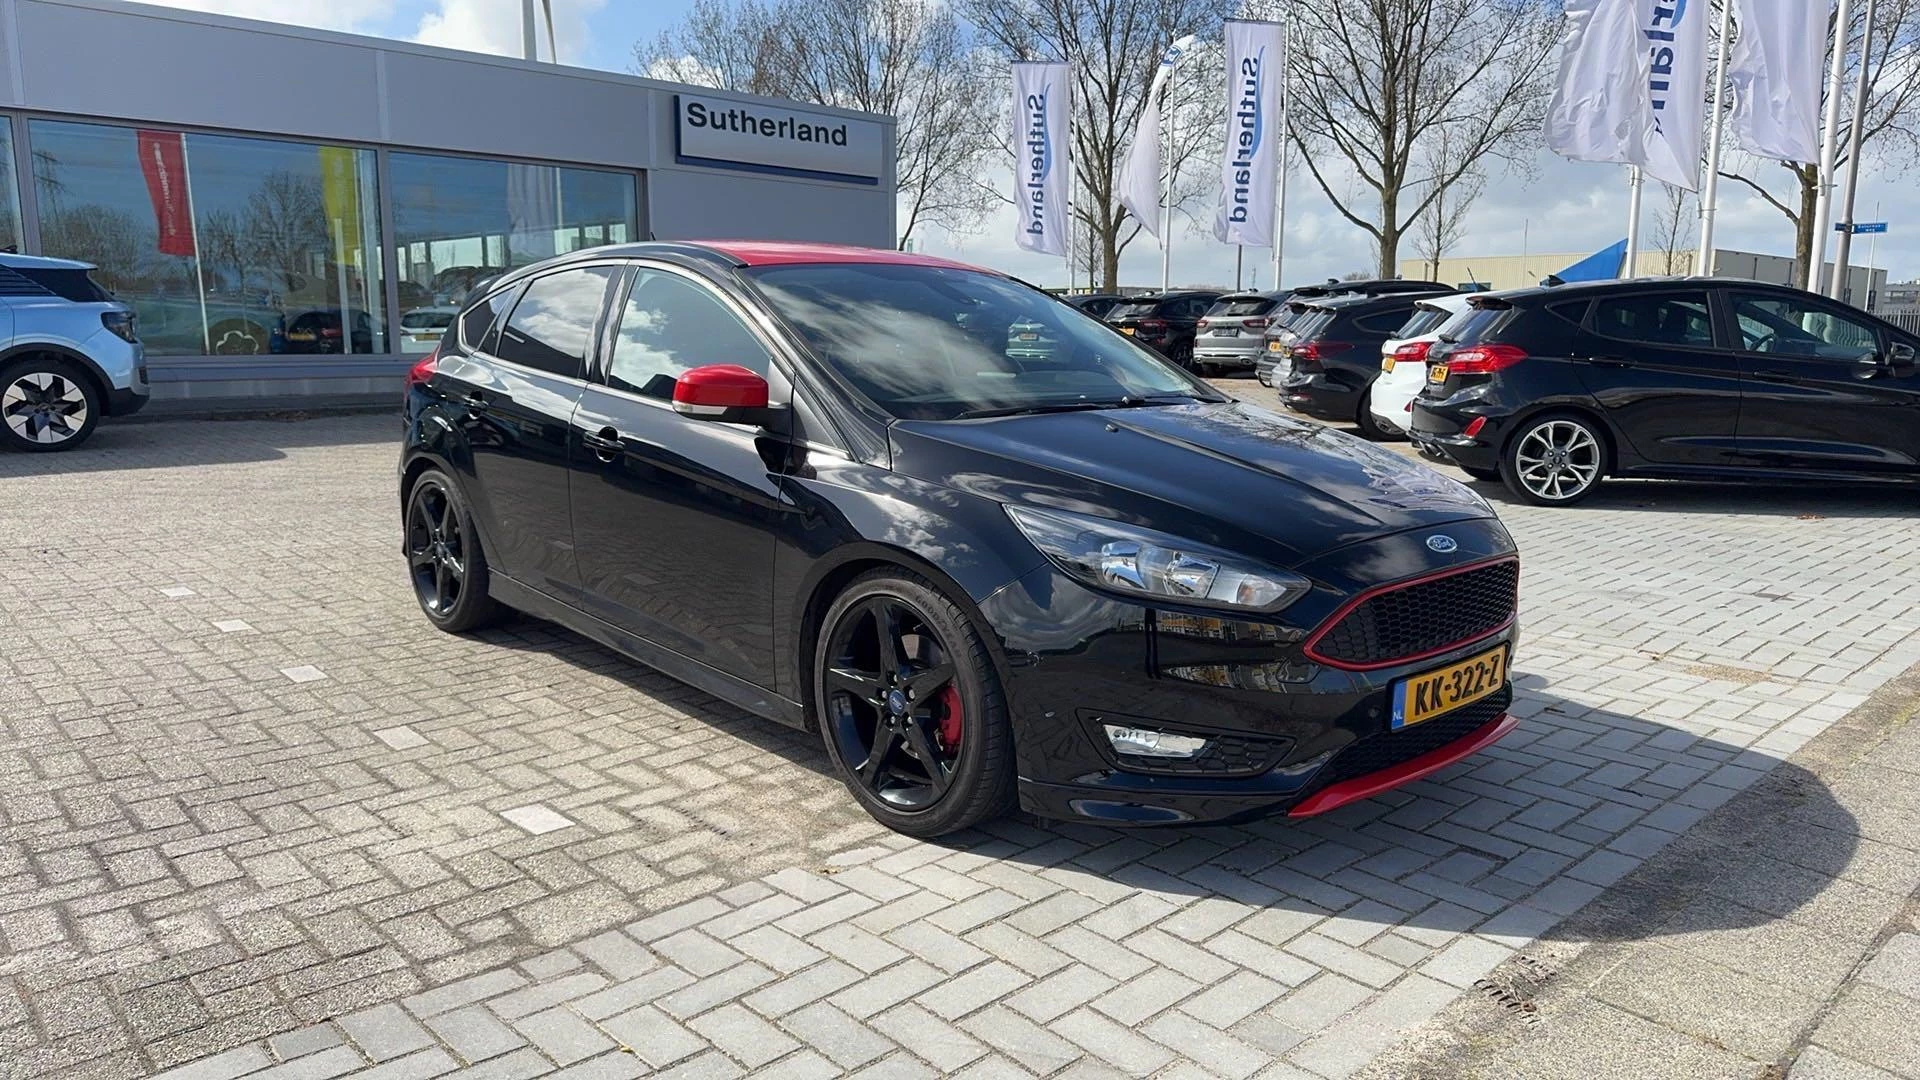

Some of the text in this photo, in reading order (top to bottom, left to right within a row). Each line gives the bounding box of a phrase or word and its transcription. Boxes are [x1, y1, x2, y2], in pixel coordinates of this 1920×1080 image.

[686, 102, 848, 147] Sutherland
[1414, 654, 1501, 716] KK-322-Z
[1392, 711, 1403, 721] NL
